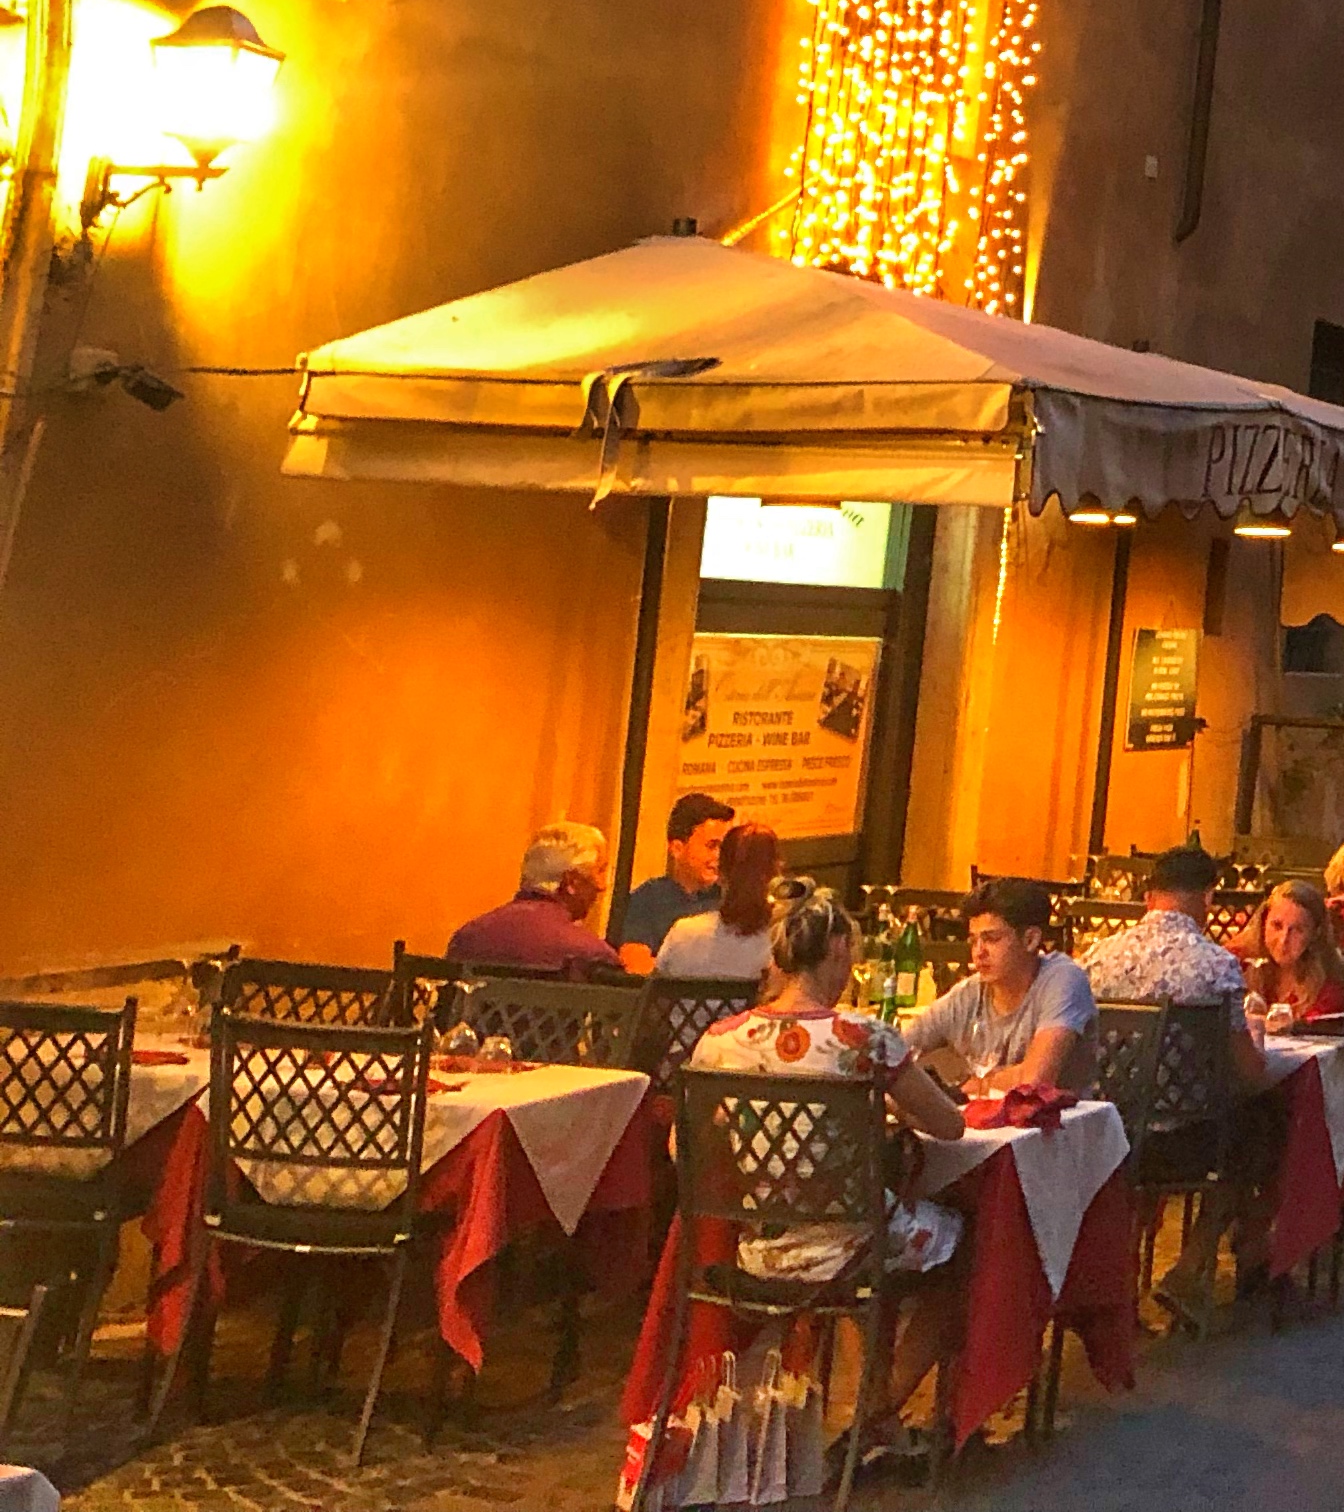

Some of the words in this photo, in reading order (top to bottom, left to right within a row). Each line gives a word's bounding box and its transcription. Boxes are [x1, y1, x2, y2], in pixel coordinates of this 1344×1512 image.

[732, 710, 794, 727] RISTORANTE
[707, 732, 752, 748] PIZZERIA
[762, 731, 789, 747] WINE
[790, 731, 811, 746] BAR
